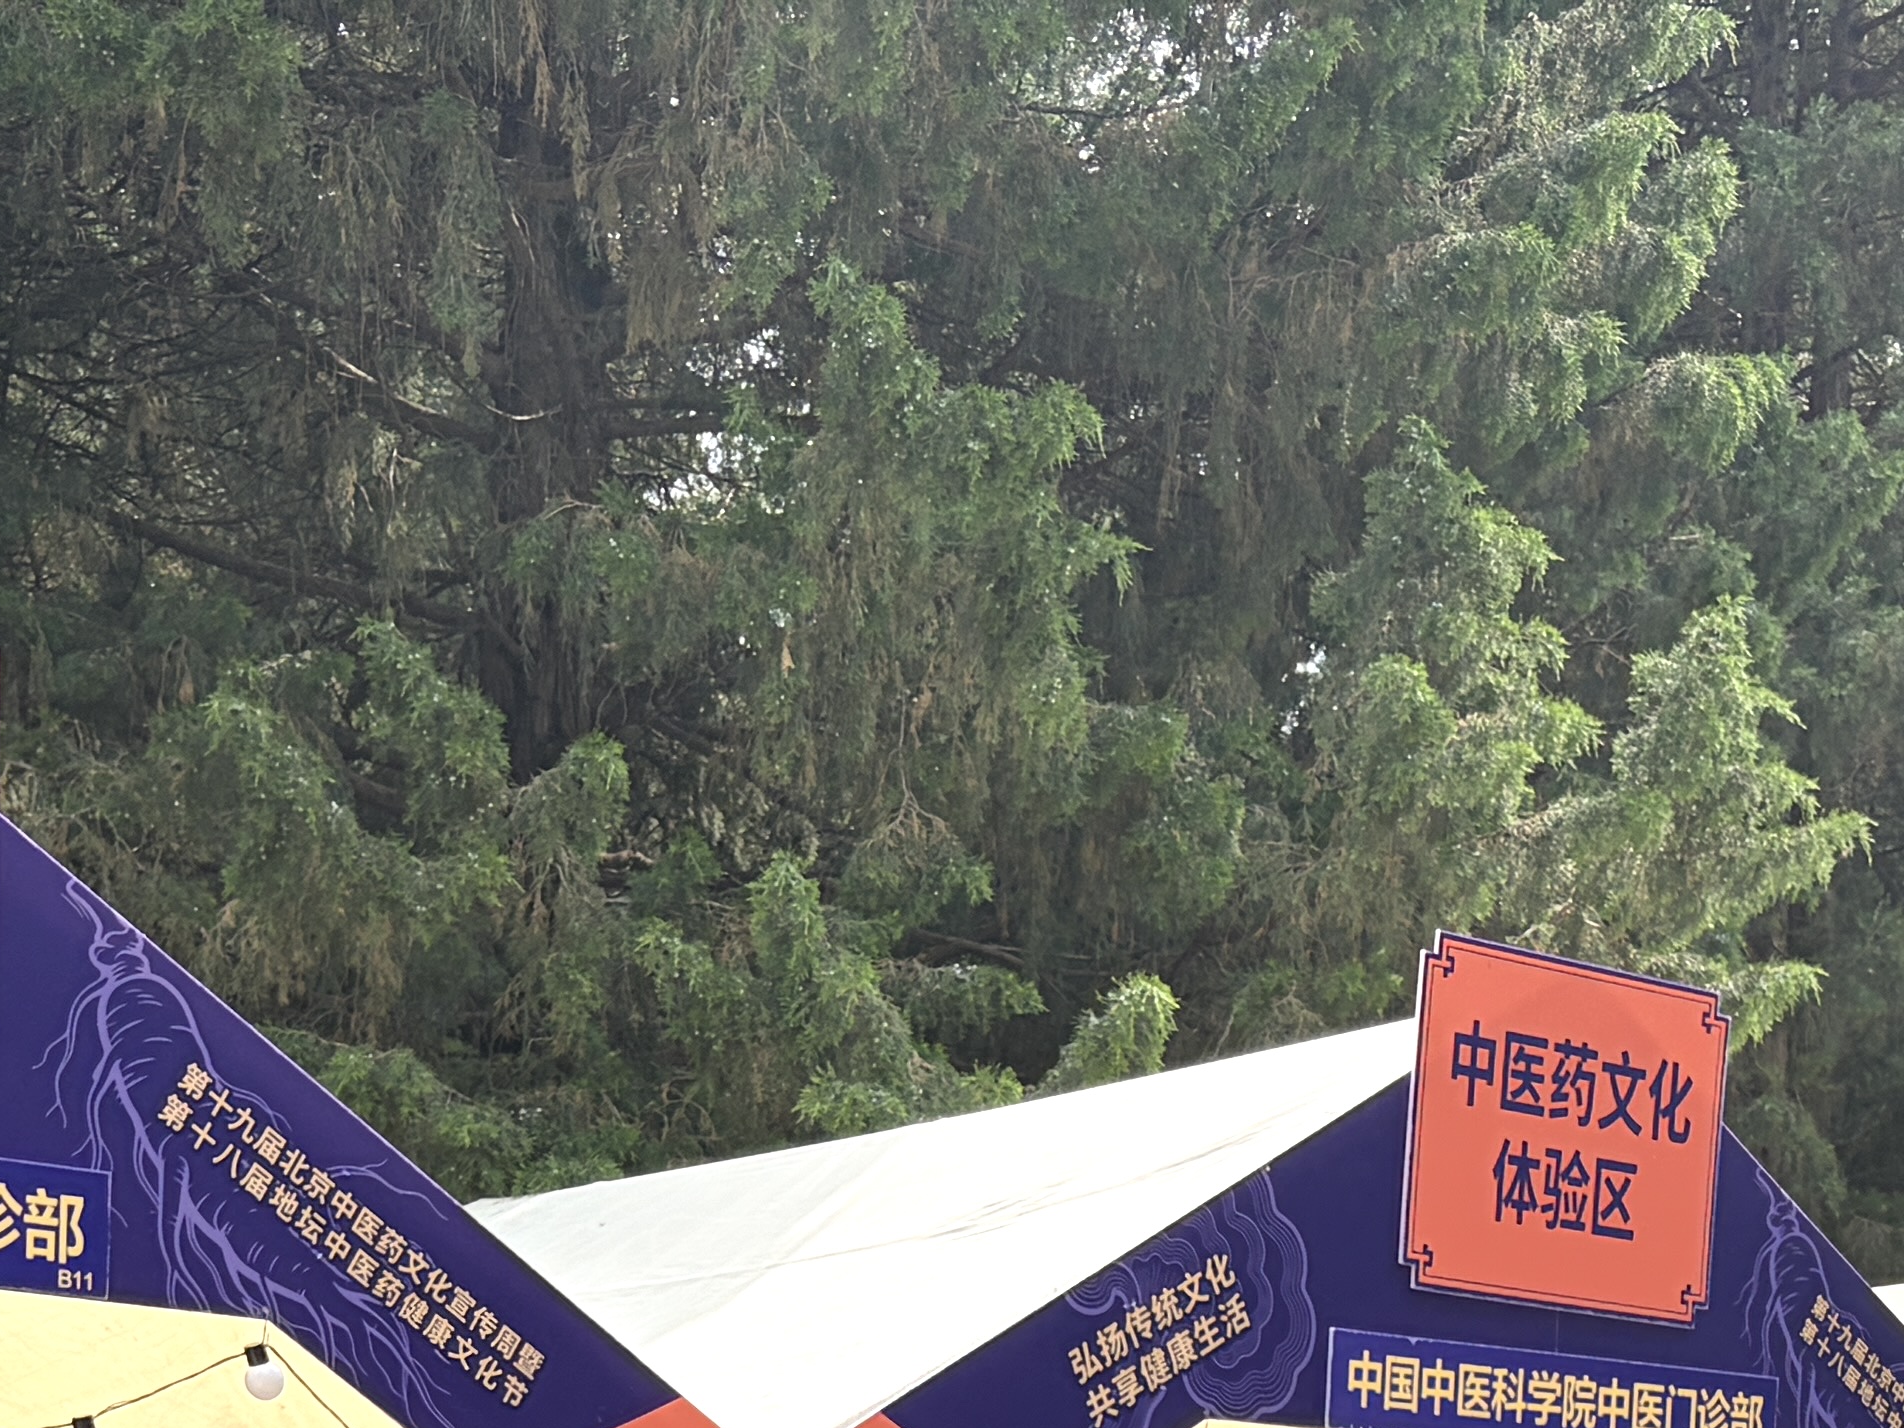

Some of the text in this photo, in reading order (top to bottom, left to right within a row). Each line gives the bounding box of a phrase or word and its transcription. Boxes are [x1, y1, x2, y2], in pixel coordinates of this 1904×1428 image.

[1451, 1019, 1695, 1145] 中医药文化
[157, 1093, 530, 1408] 第十八届地坛中医药健康文化节
[177, 1061, 546, 1381] 第十九届北京中医药文化宣传周暨
[1492, 1138, 1638, 1241] 体验区
[57, 1268, 94, 1291] B11
[1067, 1253, 1237, 1386] 弘扬传统文化
[1085, 1292, 1252, 1428] 共享健康生活
